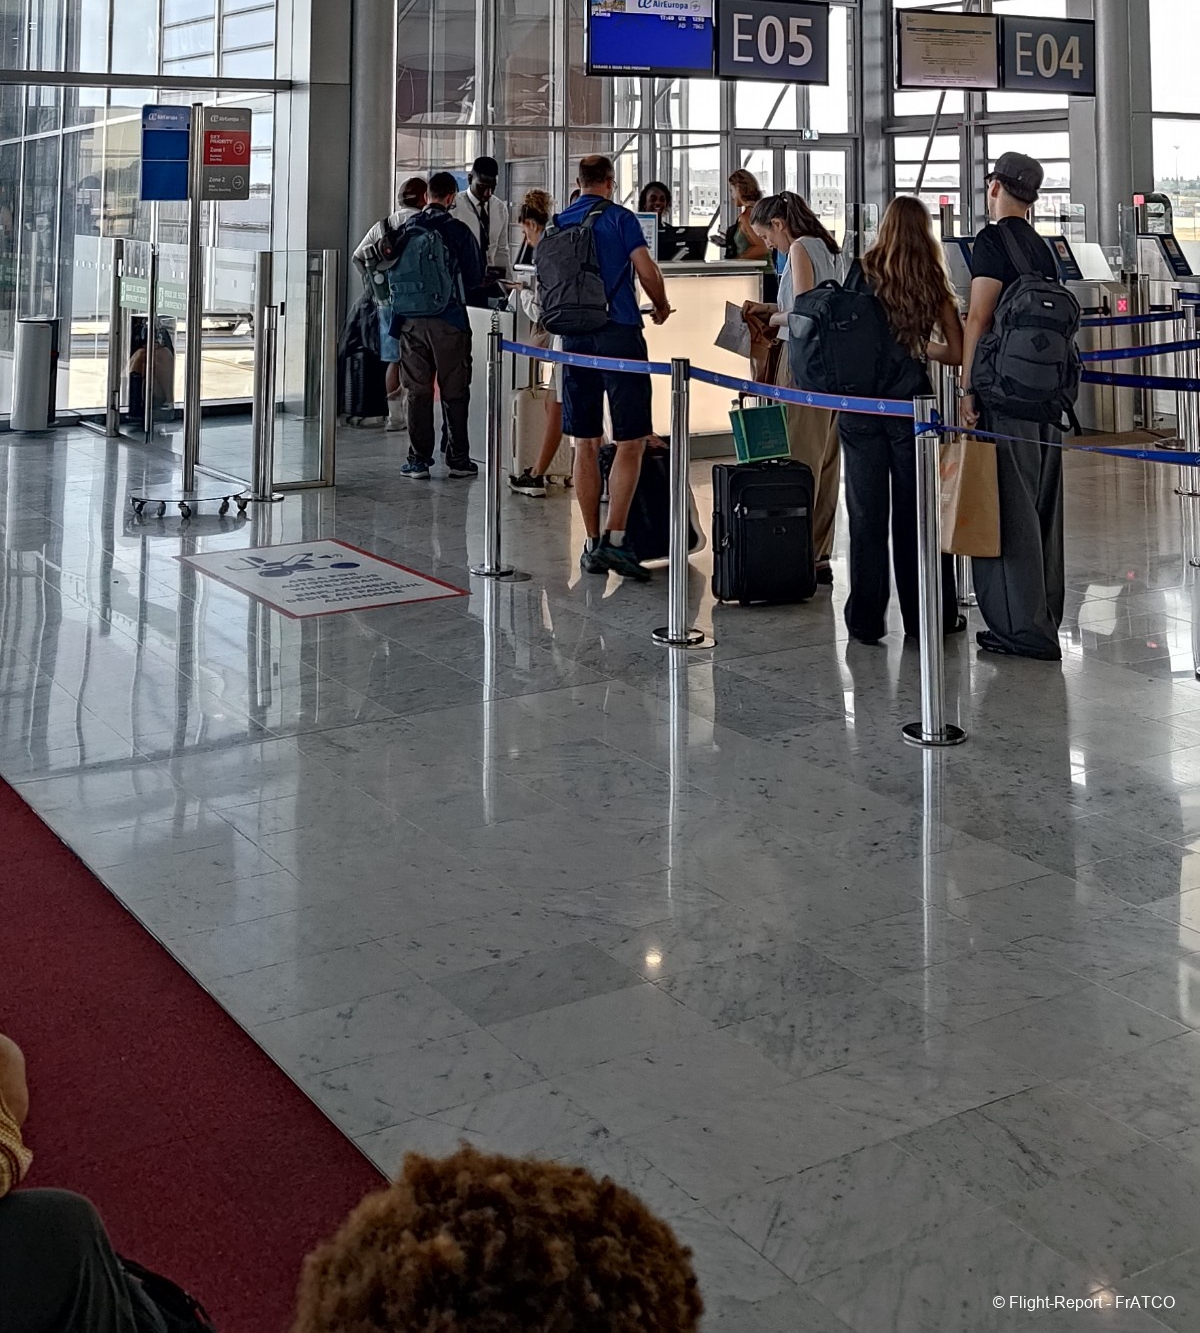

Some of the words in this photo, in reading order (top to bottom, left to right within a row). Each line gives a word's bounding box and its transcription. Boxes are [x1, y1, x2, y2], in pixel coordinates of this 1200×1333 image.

[652, 0, 689, 10] AirEuropa
[733, 13, 813, 66] E05
[1015, 31, 1083, 79] E04
